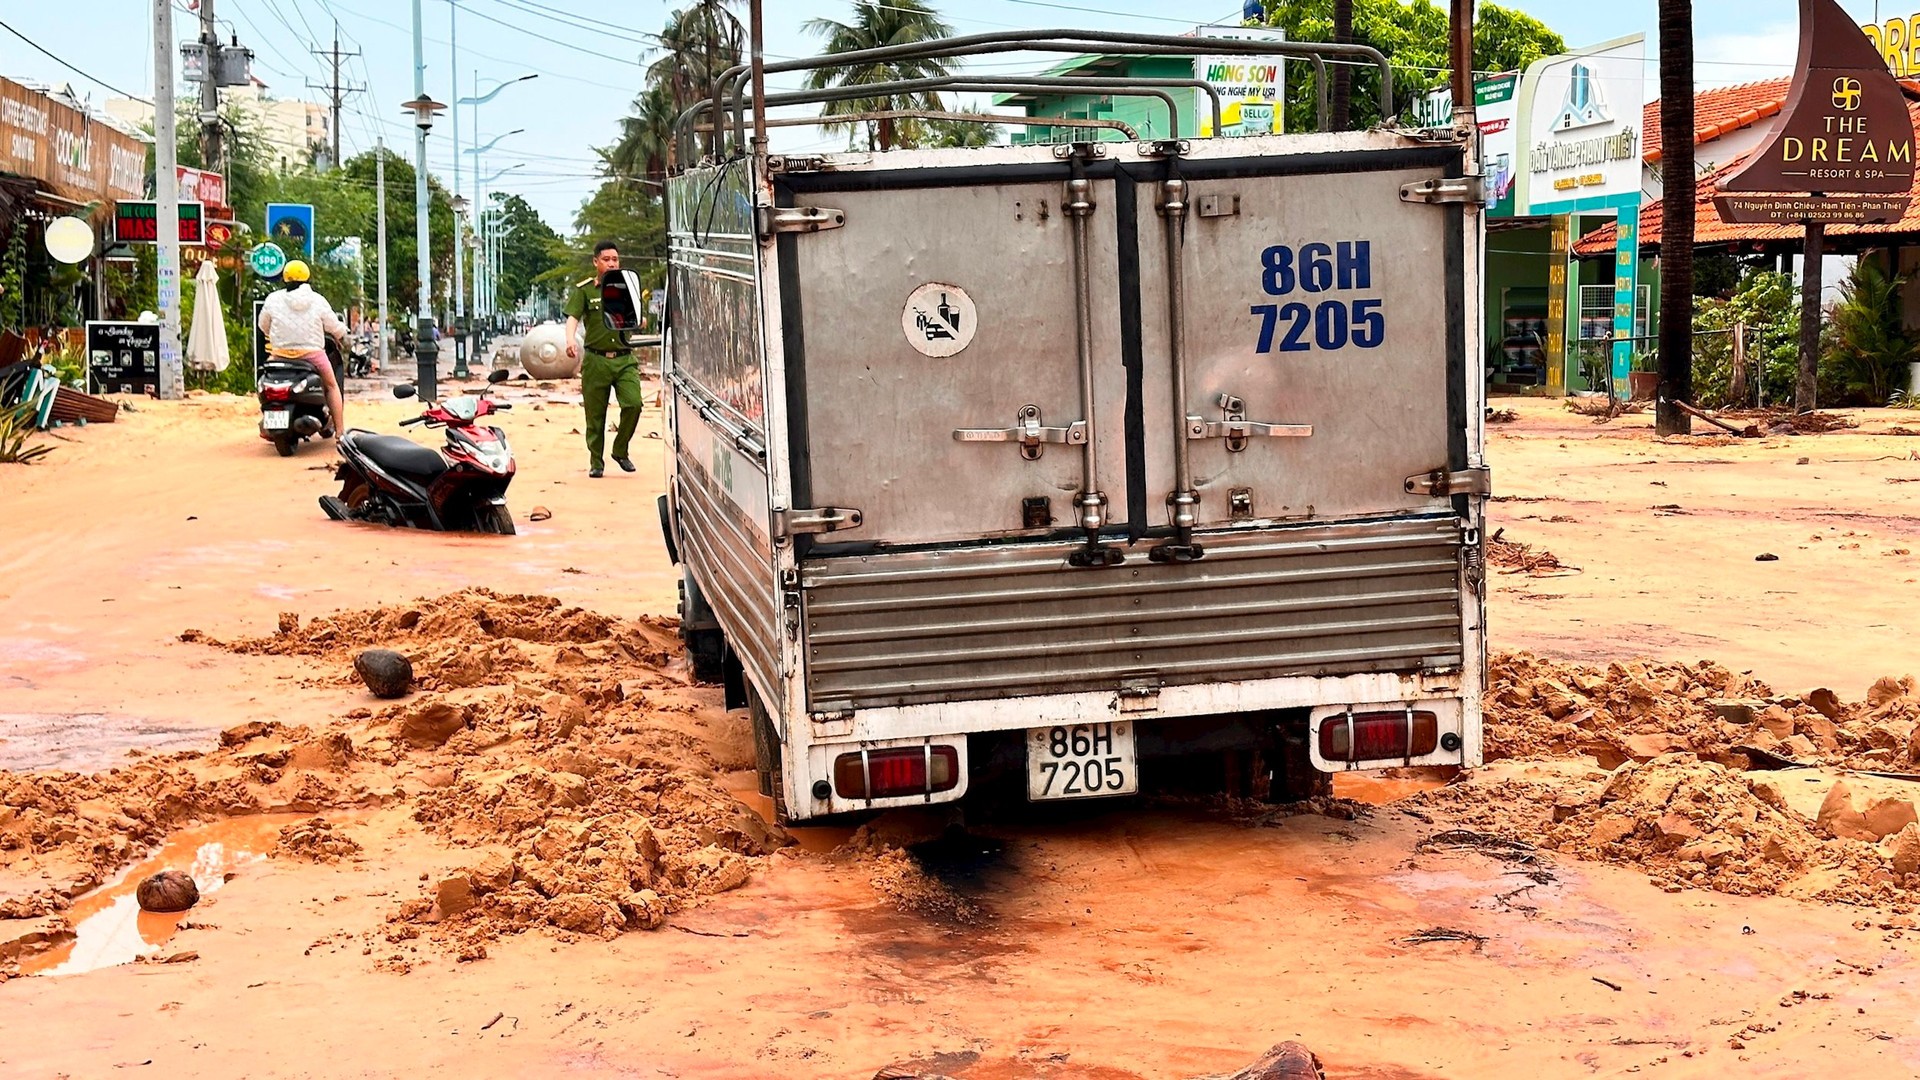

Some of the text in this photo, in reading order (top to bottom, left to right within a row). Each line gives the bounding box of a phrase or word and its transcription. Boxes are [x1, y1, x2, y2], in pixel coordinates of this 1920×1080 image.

[1206, 60, 1277, 83] HÃNG SƠN
[1262, 87, 1276, 98] USA
[1823, 116, 1867, 134] THE
[1548, 140, 1576, 171] VÀNG
[1575, 137, 1604, 167] PHAN
[1603, 125, 1638, 162] THIẾT
[1783, 137, 1911, 163] DREAM
[1810, 168, 1884, 179] RESORT & SPA
[1734, 201, 1743, 209] 74
[1862, 201, 1881, 210] Phan
[1808, 211, 1831, 219] 02523
[119, 218, 199, 240] MASGE
[258, 255, 277, 266] SPA
[1260, 240, 1371, 296] 86H
[1250, 298, 1385, 354] 7205
[1049, 722, 1112, 758] 86H
[1039, 757, 1124, 796] 7205
